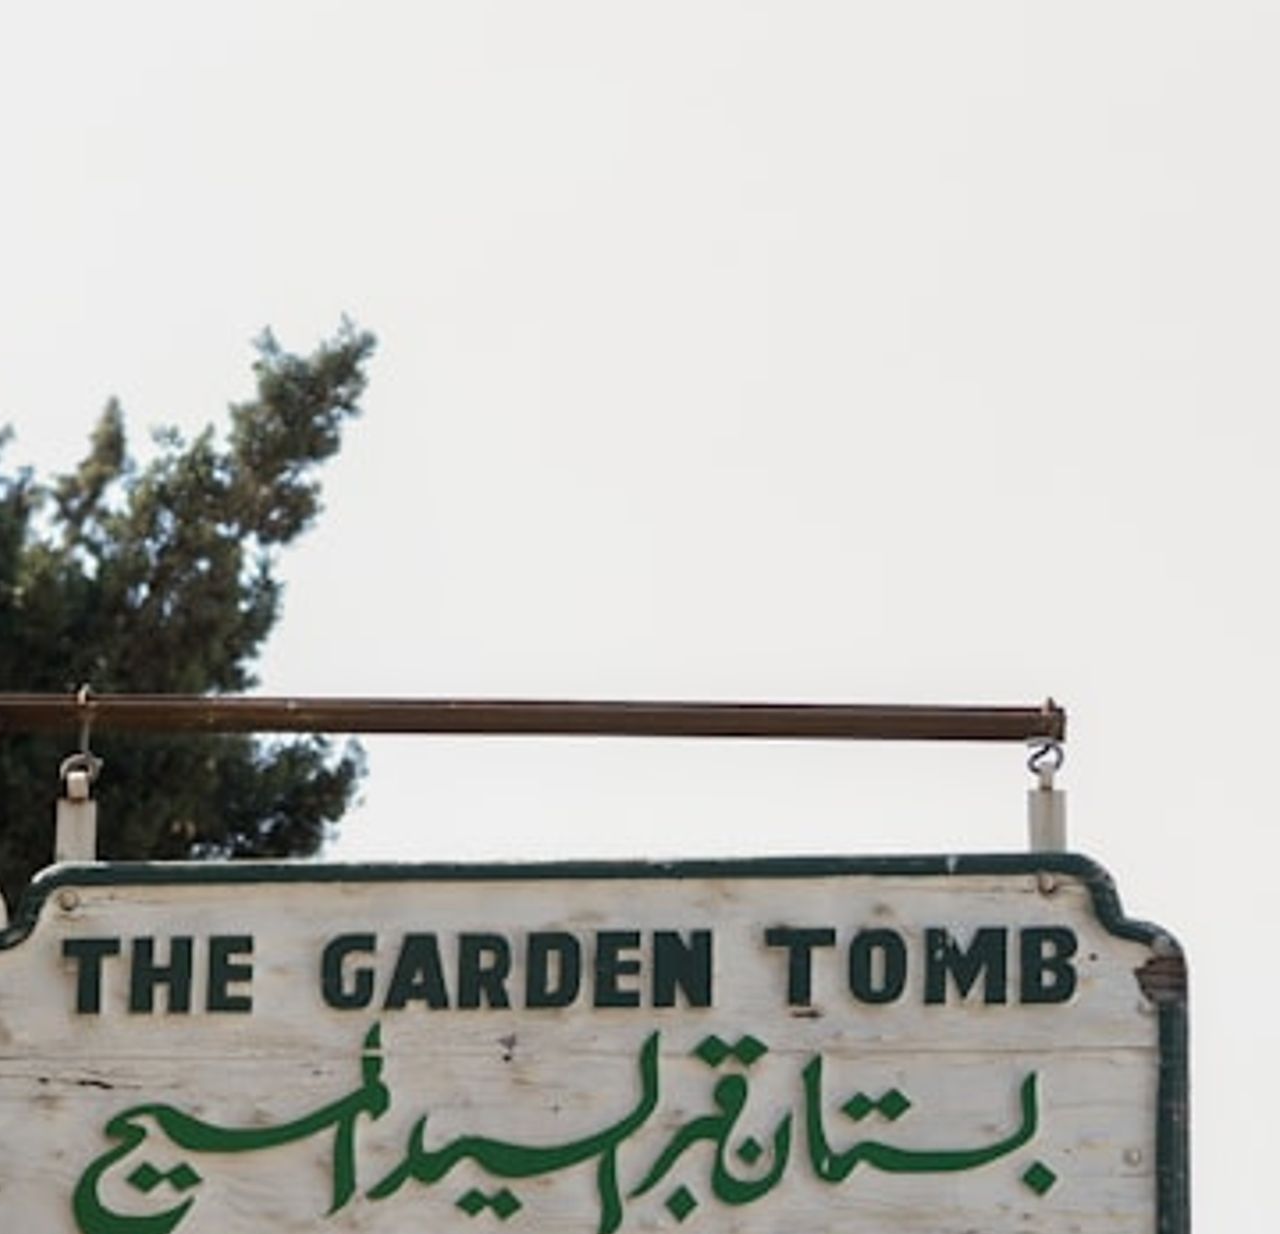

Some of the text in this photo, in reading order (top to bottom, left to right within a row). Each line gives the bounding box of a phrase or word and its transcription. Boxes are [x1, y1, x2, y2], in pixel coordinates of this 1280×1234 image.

[60, 924, 1080, 1016] THE GARDEN TOMB
[624, 1033, 770, 1223] قبر
[710, 1053, 1058, 1206] بستان
